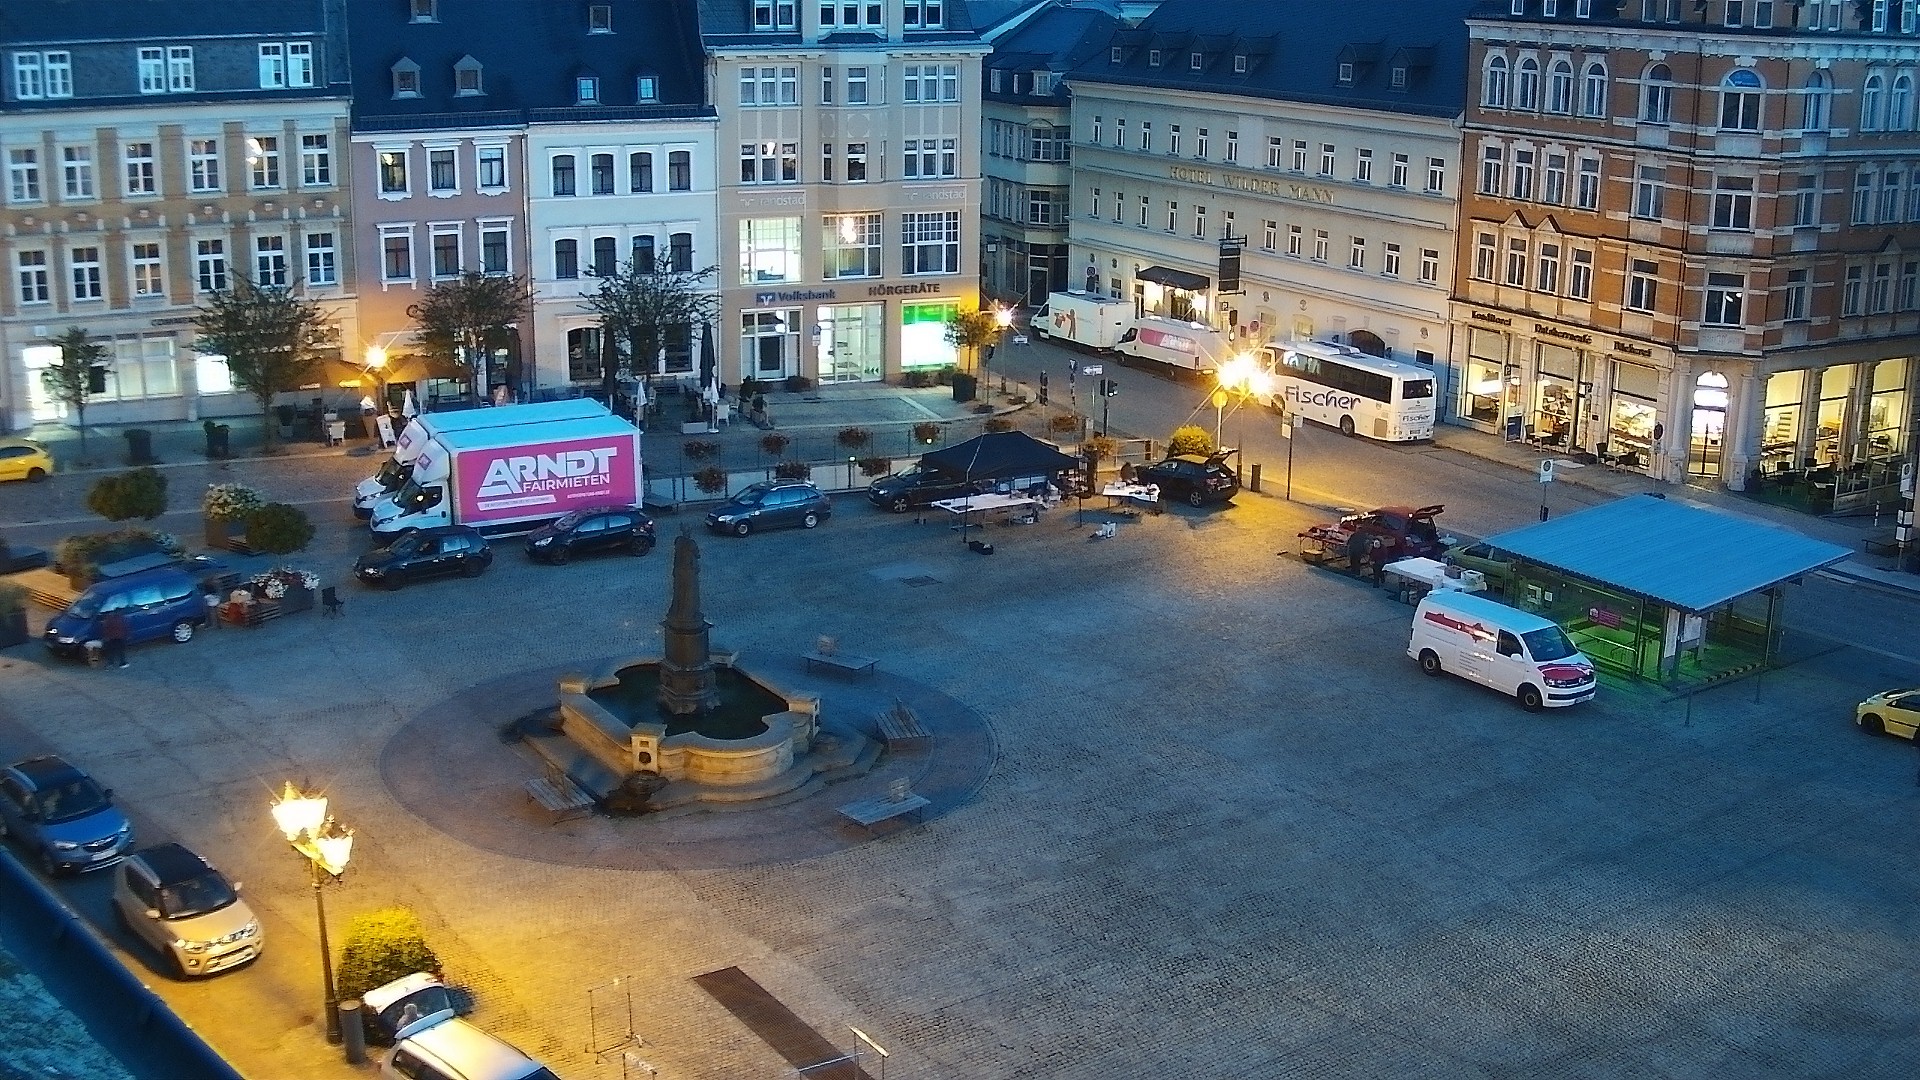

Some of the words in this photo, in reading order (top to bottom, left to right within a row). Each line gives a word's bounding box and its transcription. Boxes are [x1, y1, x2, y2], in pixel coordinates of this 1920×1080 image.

[1170, 166, 1213, 184] HOTEL
[1222, 174, 1280, 195] WILDER
[1289, 184, 1334, 204] MANN
[759, 195, 806, 206] randstad
[921, 190, 965, 200] randstad
[777, 288, 836, 302] Volksbank
[868, 282, 940, 296] HÖRGERÄTE
[1285, 385, 1361, 410] Fischer
[1402, 414, 1431, 422] Fischer
[477, 447, 618, 498] ARNDT
[523, 474, 611, 493] FAIRMIETEN
